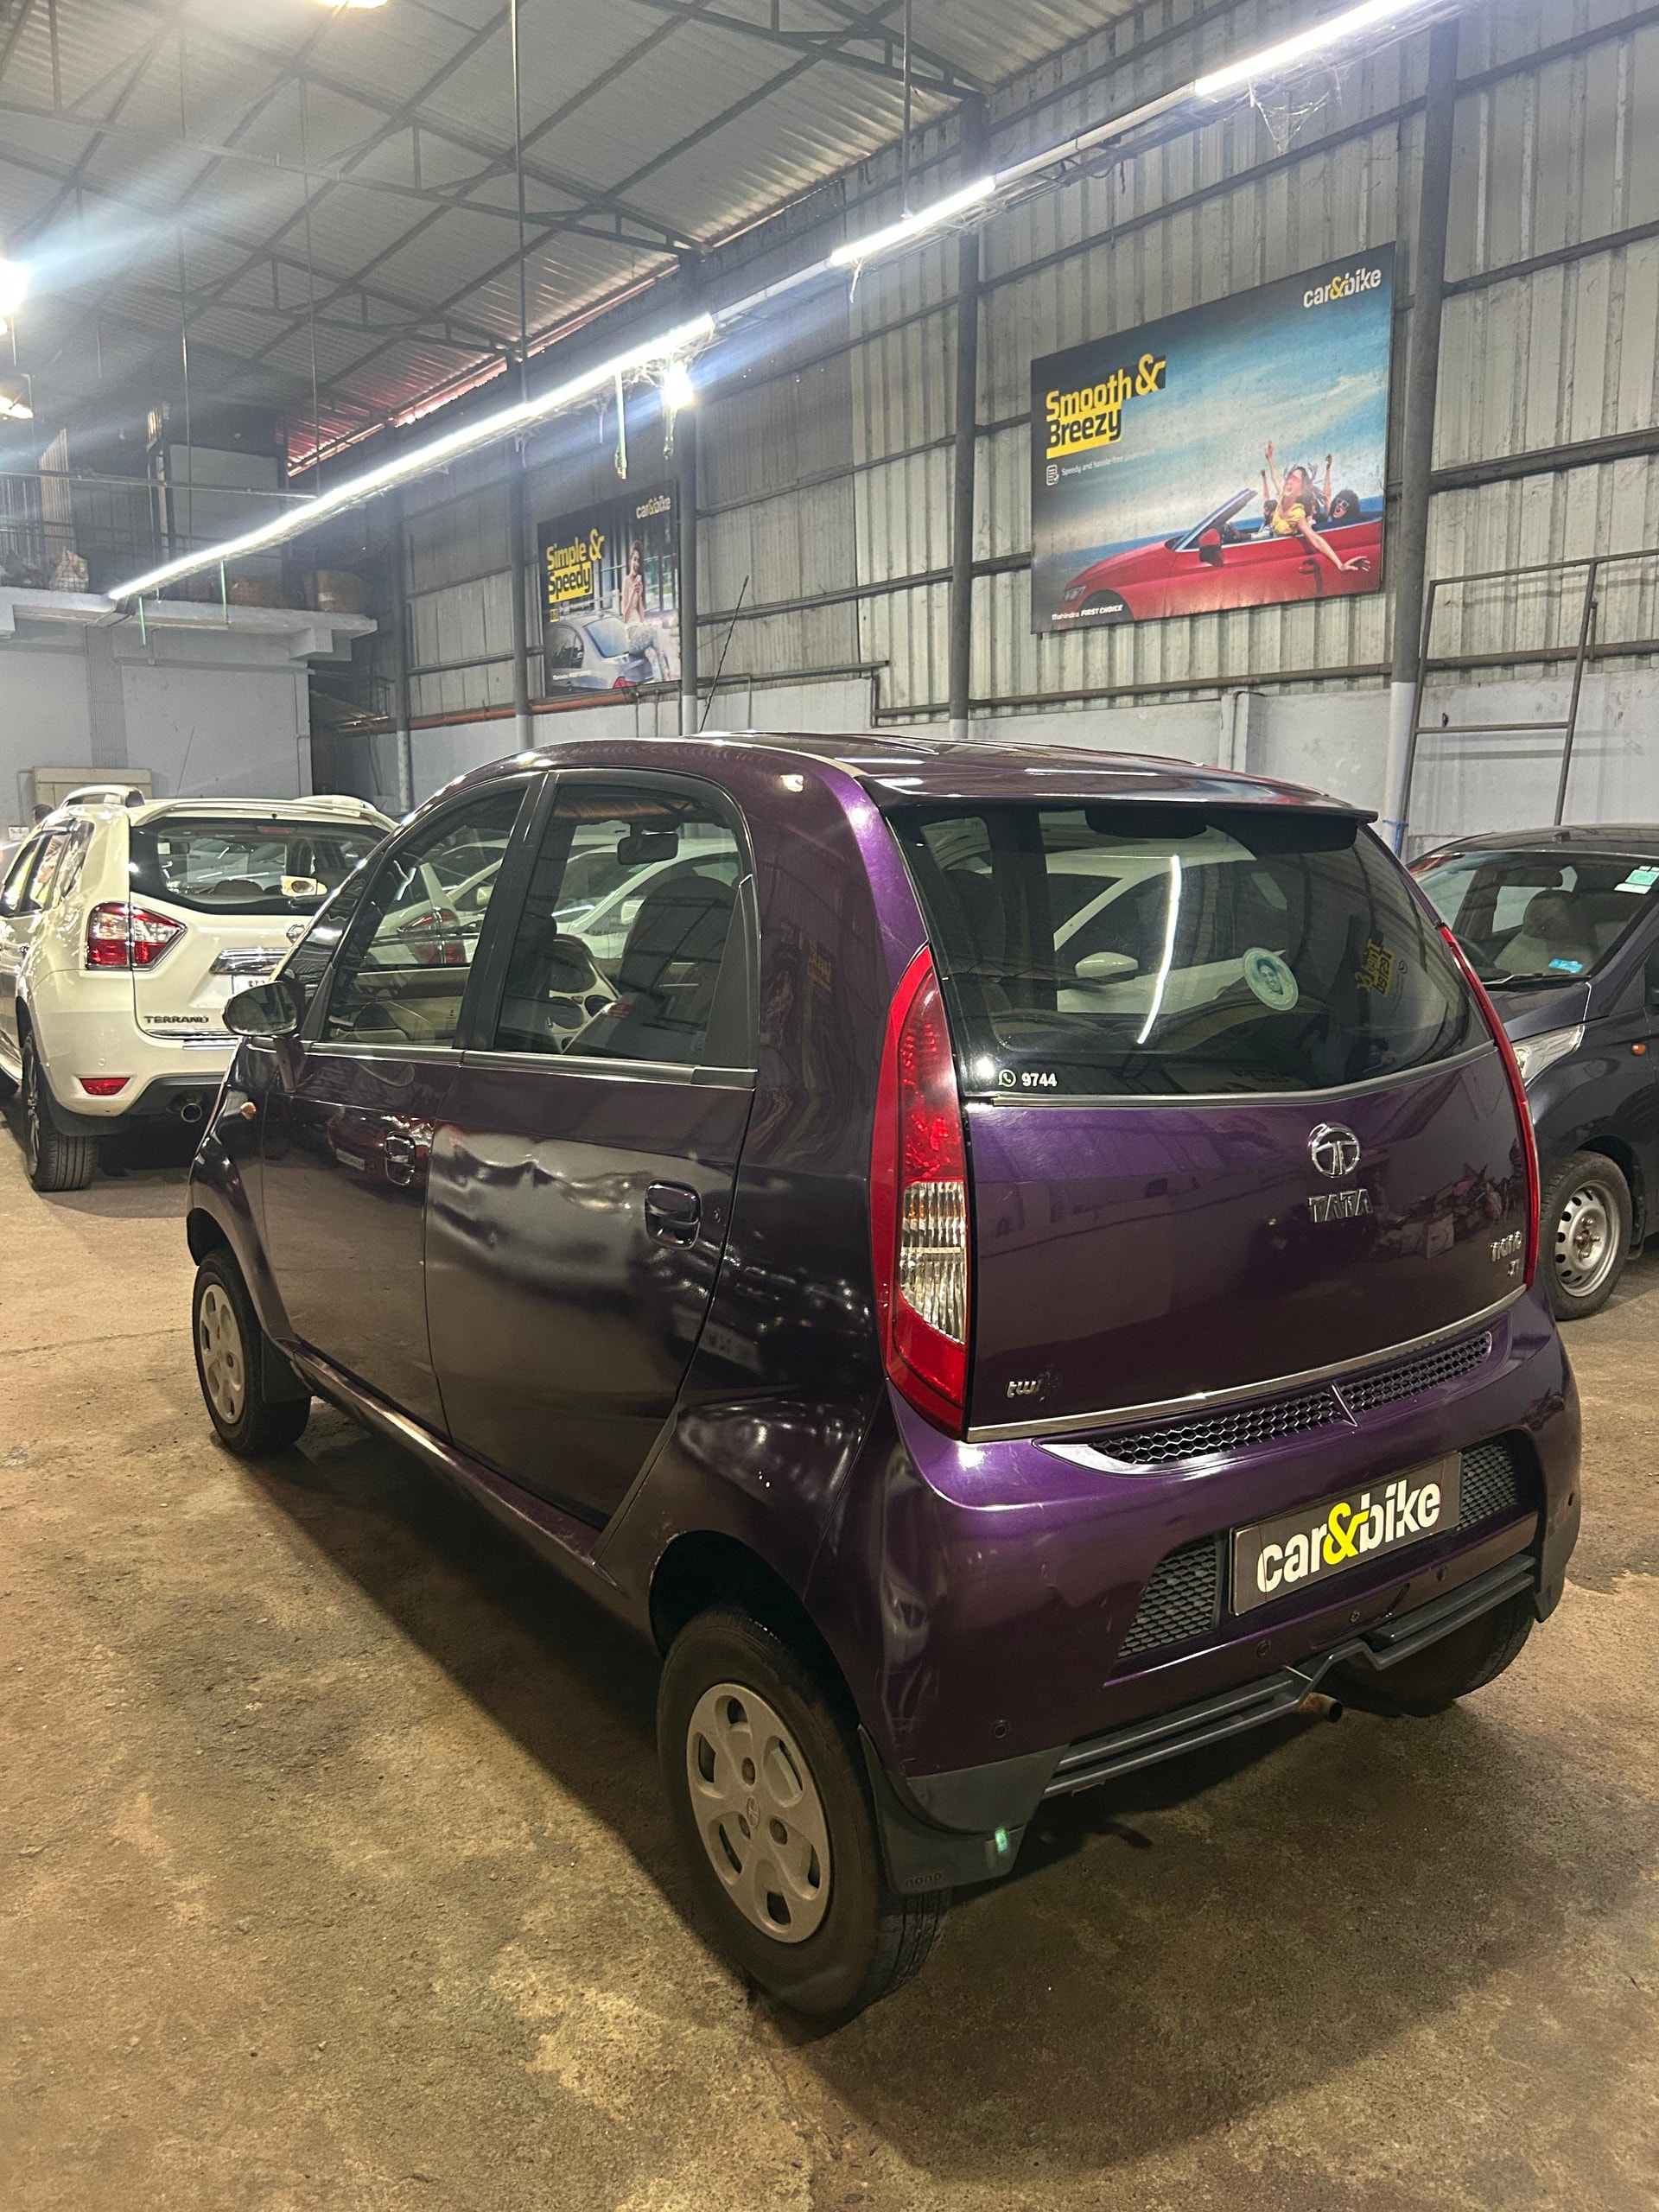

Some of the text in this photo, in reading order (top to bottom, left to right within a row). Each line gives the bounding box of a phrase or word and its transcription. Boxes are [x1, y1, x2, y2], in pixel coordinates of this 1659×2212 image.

[1303, 267, 1382, 308] car&bike
[1046, 353, 1166, 422] Smooth &
[1046, 408, 1122, 448] Breezy
[1061, 465, 1082, 477] Speedy
[1082, 461, 1093, 471] and
[636, 495, 671, 519] car&bike
[546, 528, 605, 570] Simple &
[548, 567, 591, 600] Speedy
[1080, 607, 1100, 617] FIRST
[1099, 604, 1124, 614] CHOICE
[1021, 1072, 1058, 1087] 9744
[1308, 1189, 1374, 1223] TATA
[1256, 1478, 1441, 1593] car&bike
[904, 1872, 944, 1888] nano
